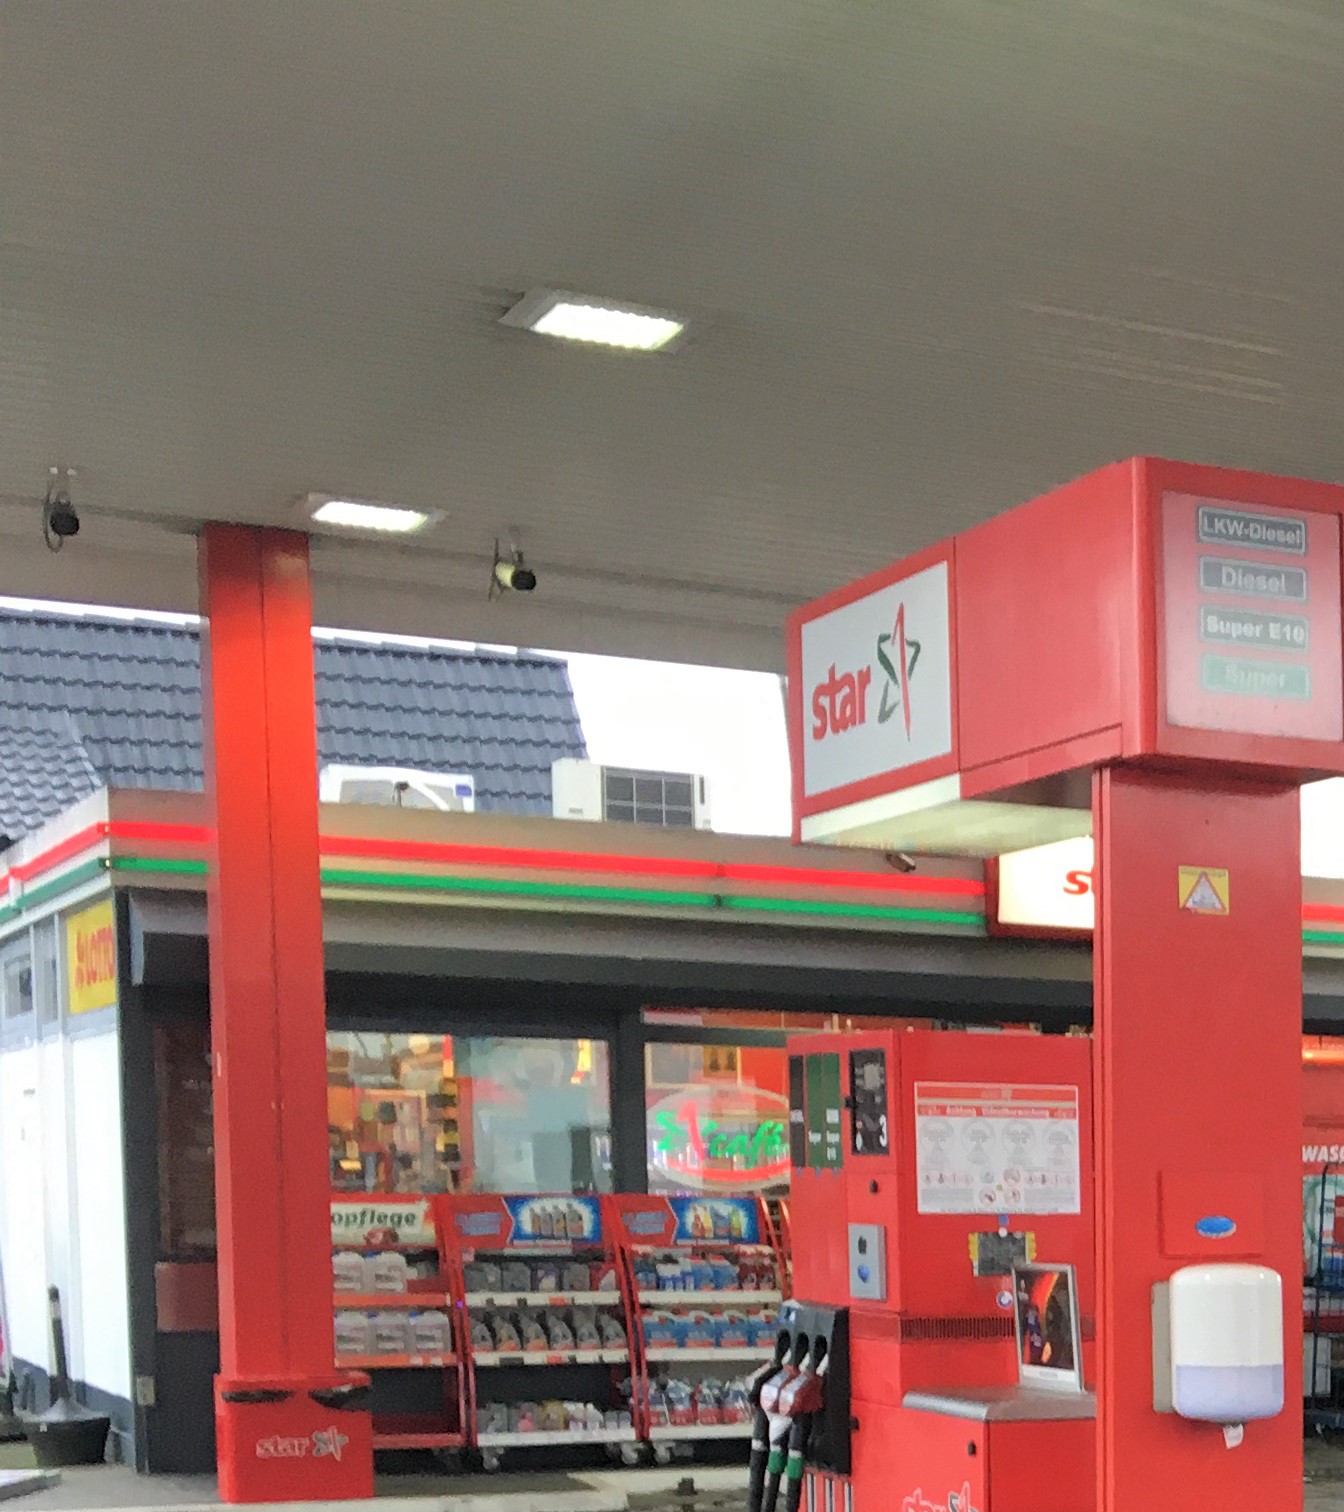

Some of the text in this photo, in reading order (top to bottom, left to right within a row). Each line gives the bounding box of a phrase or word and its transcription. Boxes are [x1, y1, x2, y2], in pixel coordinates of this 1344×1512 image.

[1203, 514, 1303, 545] LKW-Diesel
[1221, 565, 1286, 594] Diesel
[1206, 615, 1305, 643] Super E10
[1224, 663, 1287, 692] Super
[812, 662, 871, 741] star
[879, 1114, 888, 1147] 3
[256, 1435, 310, 1459] star
